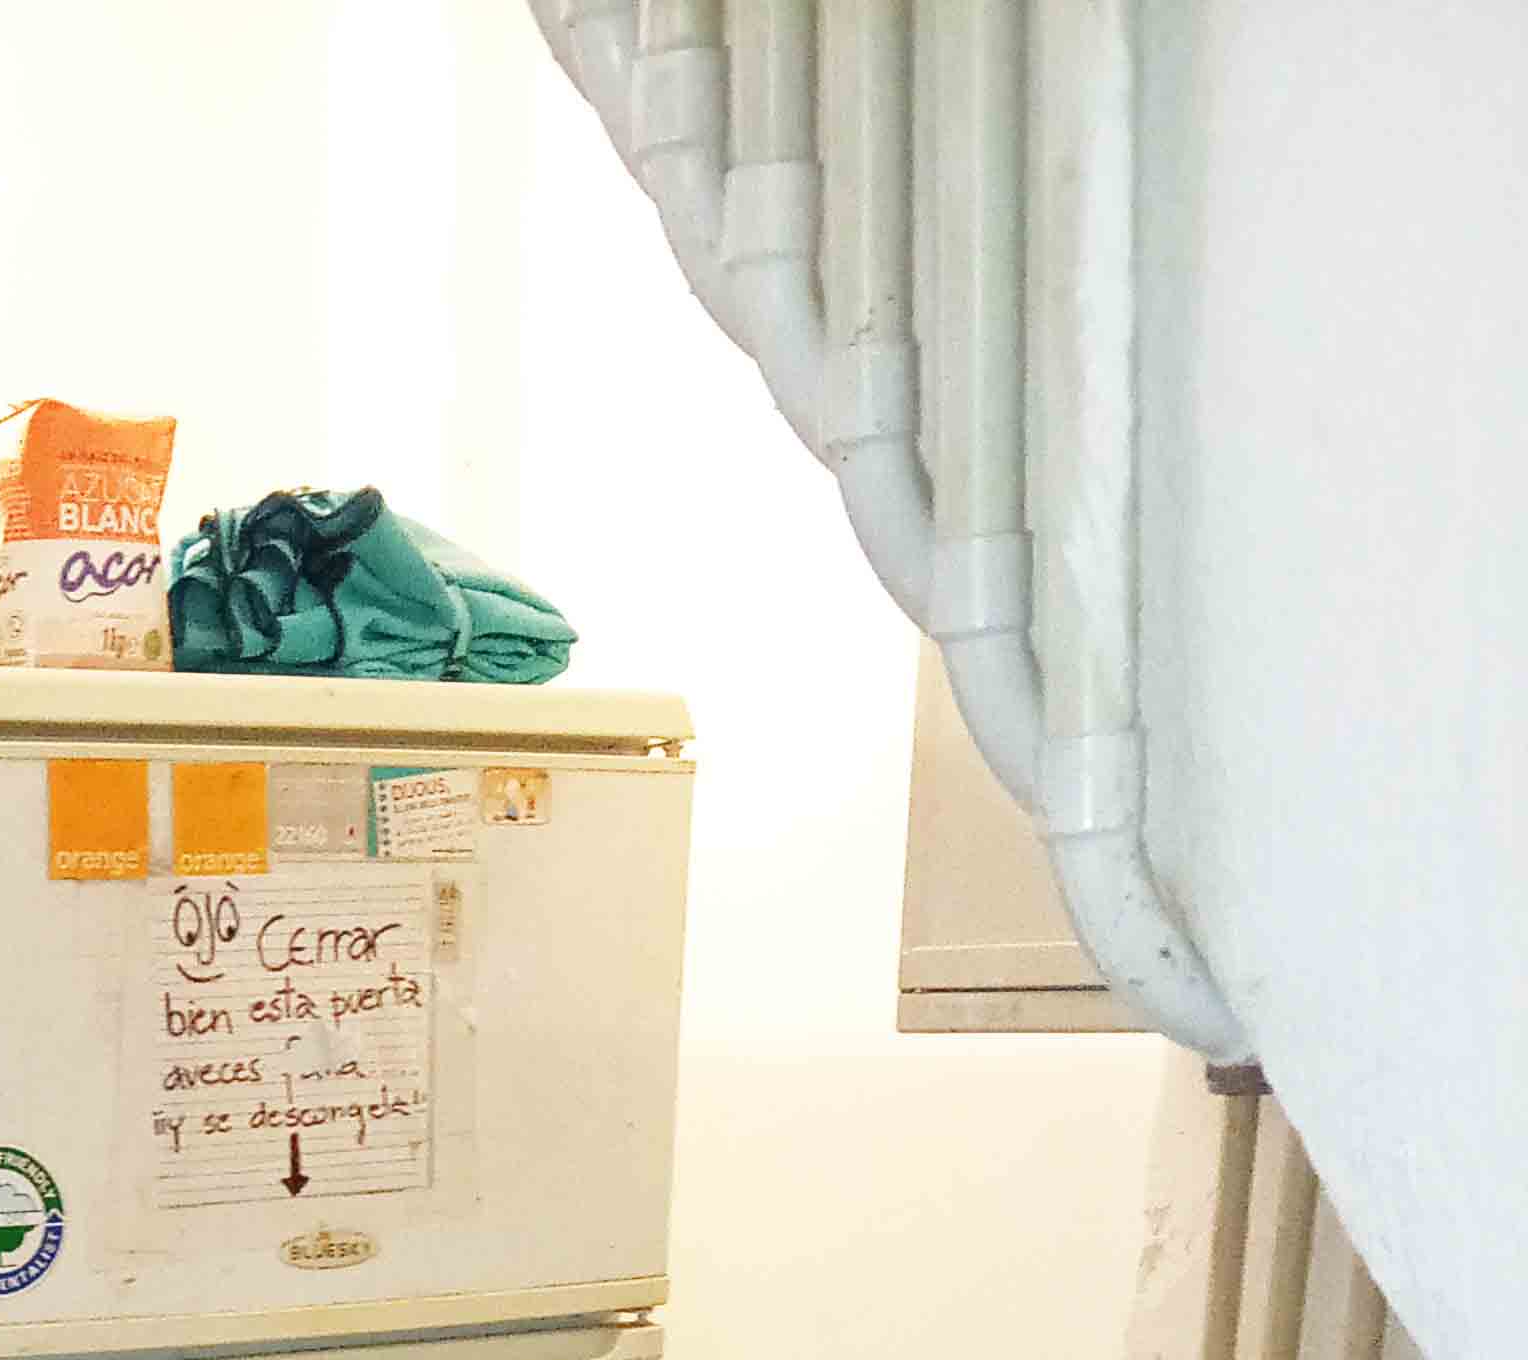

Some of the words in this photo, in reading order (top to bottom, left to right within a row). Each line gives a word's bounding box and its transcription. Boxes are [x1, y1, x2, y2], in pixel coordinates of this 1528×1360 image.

[56, 851, 140, 876] orange
[181, 852, 265, 876] orange
[256, 914, 402, 972] Cerrar
[164, 991, 233, 1037] bien
[248, 975, 321, 1023] esta
[330, 961, 424, 1033] puerta
[162, 1058, 264, 1091] aveces
[200, 1112, 233, 1135] se
